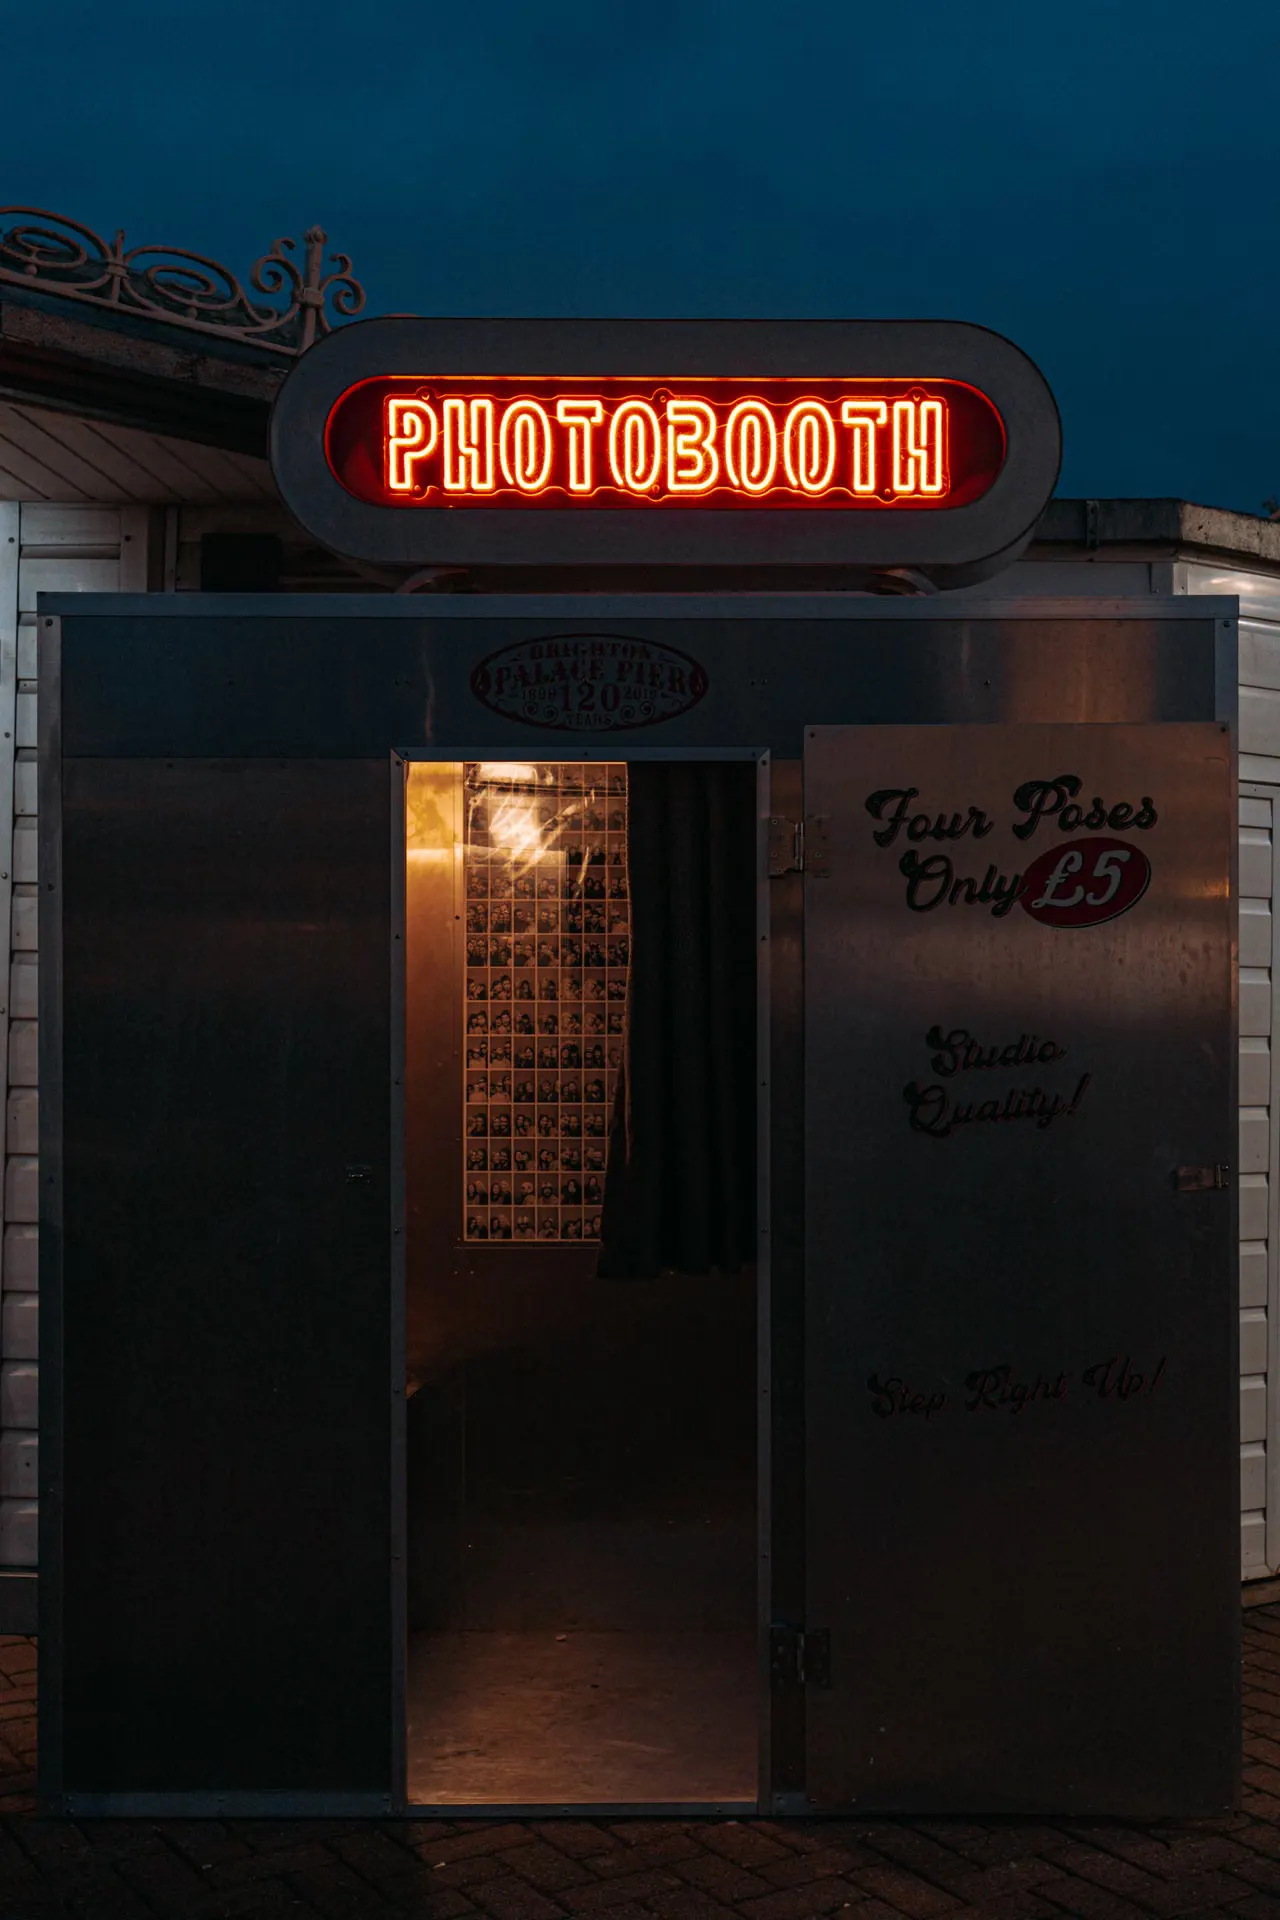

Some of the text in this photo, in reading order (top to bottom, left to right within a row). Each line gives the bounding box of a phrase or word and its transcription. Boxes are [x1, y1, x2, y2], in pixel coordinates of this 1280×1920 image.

[387, 399, 945, 493] PHOTOBOOTH
[494, 659, 687, 695] PALACE PIER
[529, 641, 652, 660] BRIGHTON
[561, 682, 621, 712] 120
[566, 713, 613, 726] YEARS
[865, 775, 1158, 848] Four Poses
[899, 850, 1132, 918] Only £5
[926, 1025, 1066, 1077] Studio
[903, 1072, 1091, 1138] Quality!
[866, 1355, 1168, 1420] Step Right Up!
